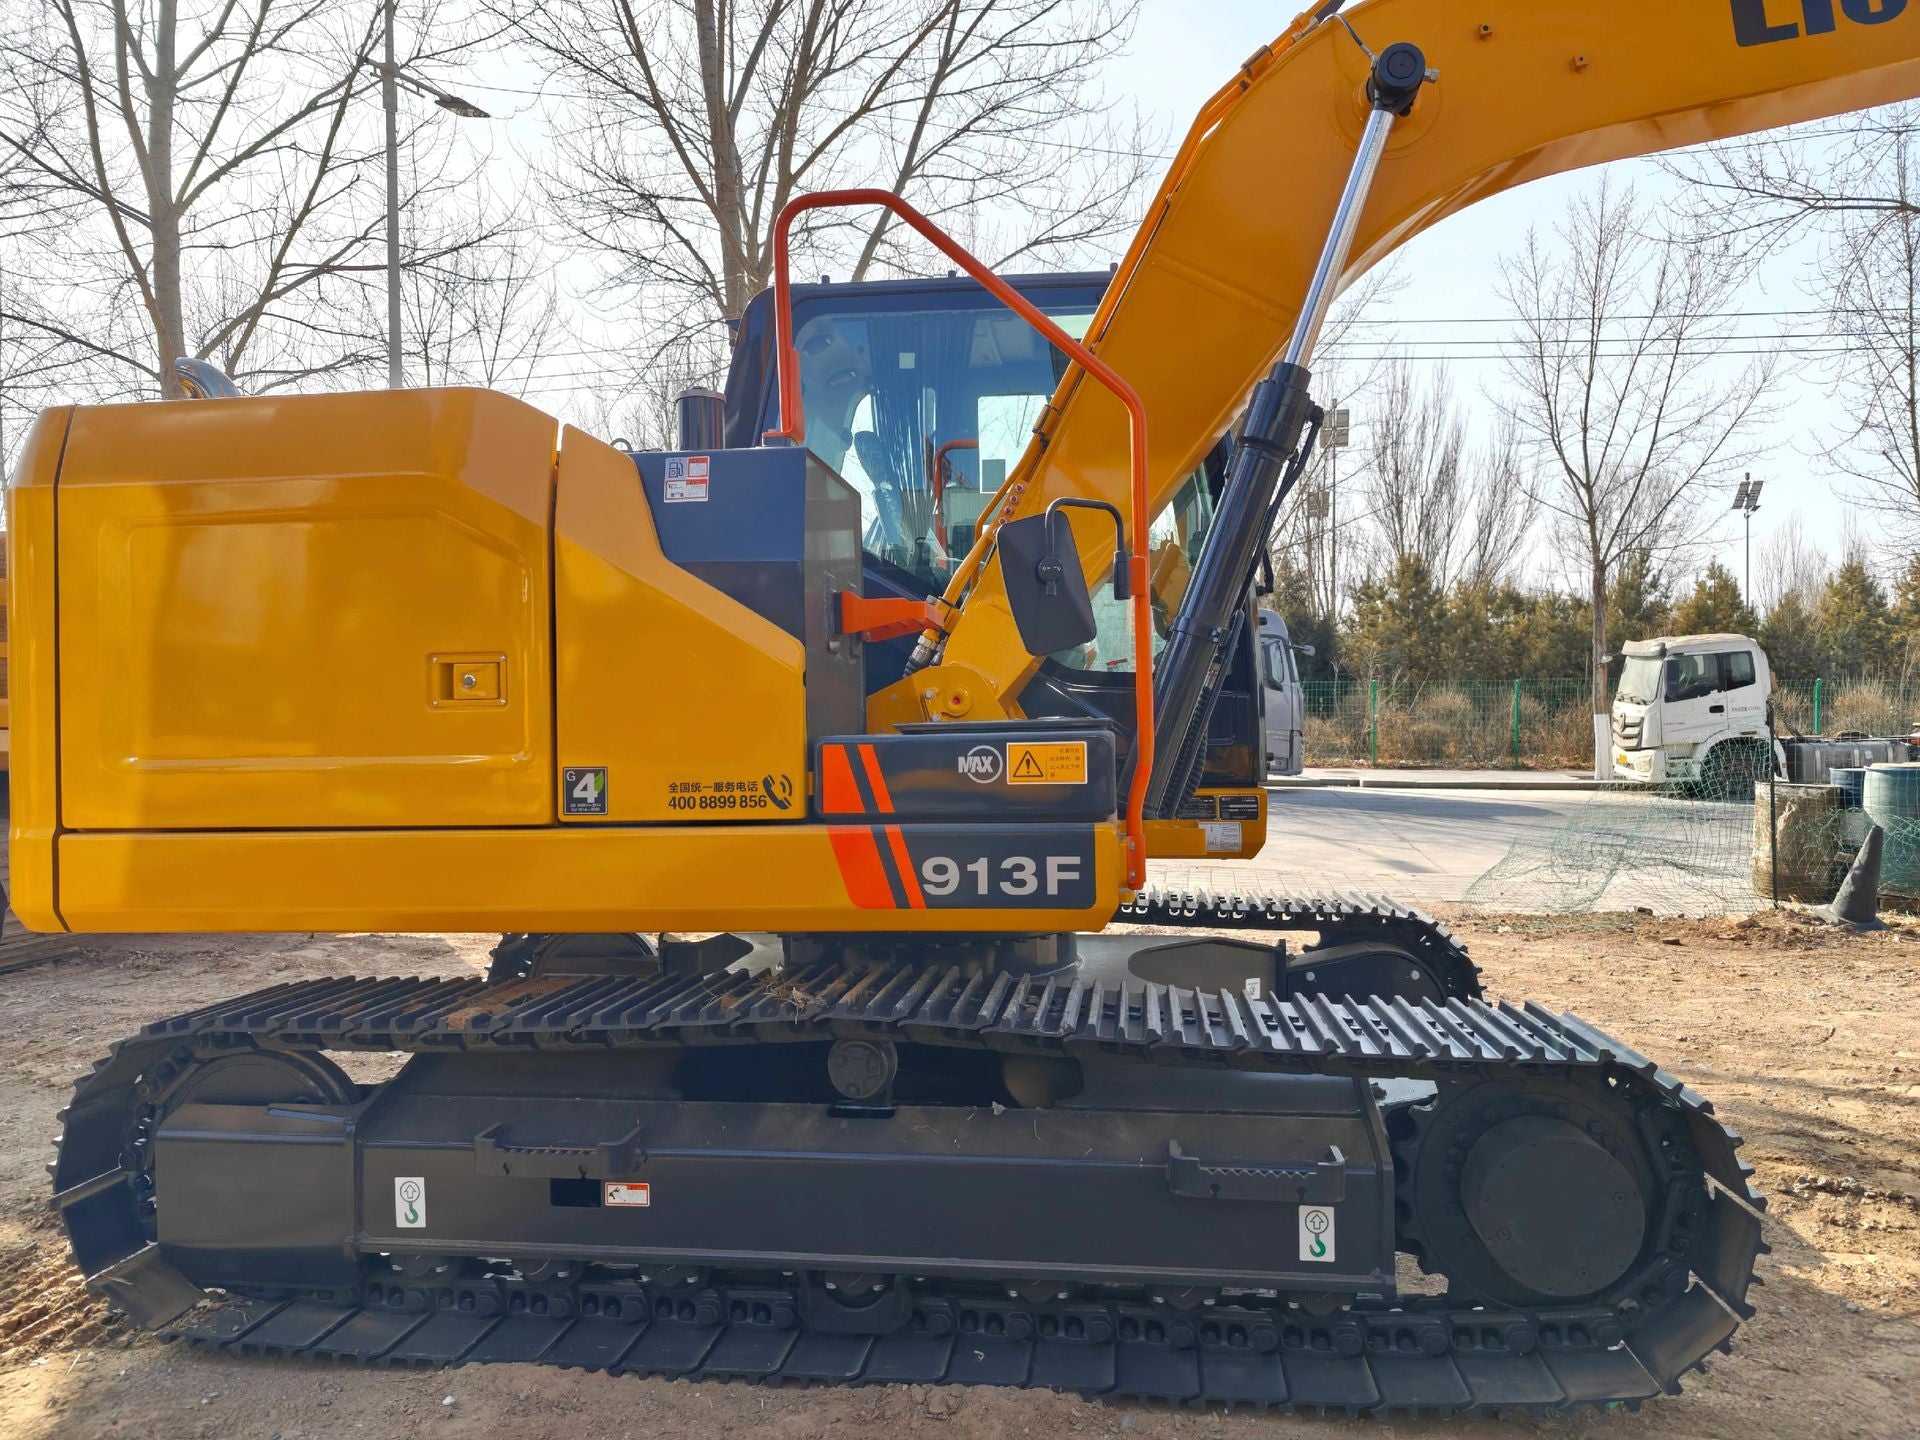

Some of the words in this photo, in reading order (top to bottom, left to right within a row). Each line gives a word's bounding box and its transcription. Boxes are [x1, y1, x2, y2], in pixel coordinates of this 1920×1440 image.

[957, 755, 994, 774] MAX
[566, 770, 576, 782] G
[572, 772, 599, 804] 4
[668, 781, 759, 794] 全国统一服务电话
[668, 796, 697, 810] 400
[699, 795, 737, 809] 8899
[739, 794, 768, 809] 856
[921, 856, 1081, 896] 913F
